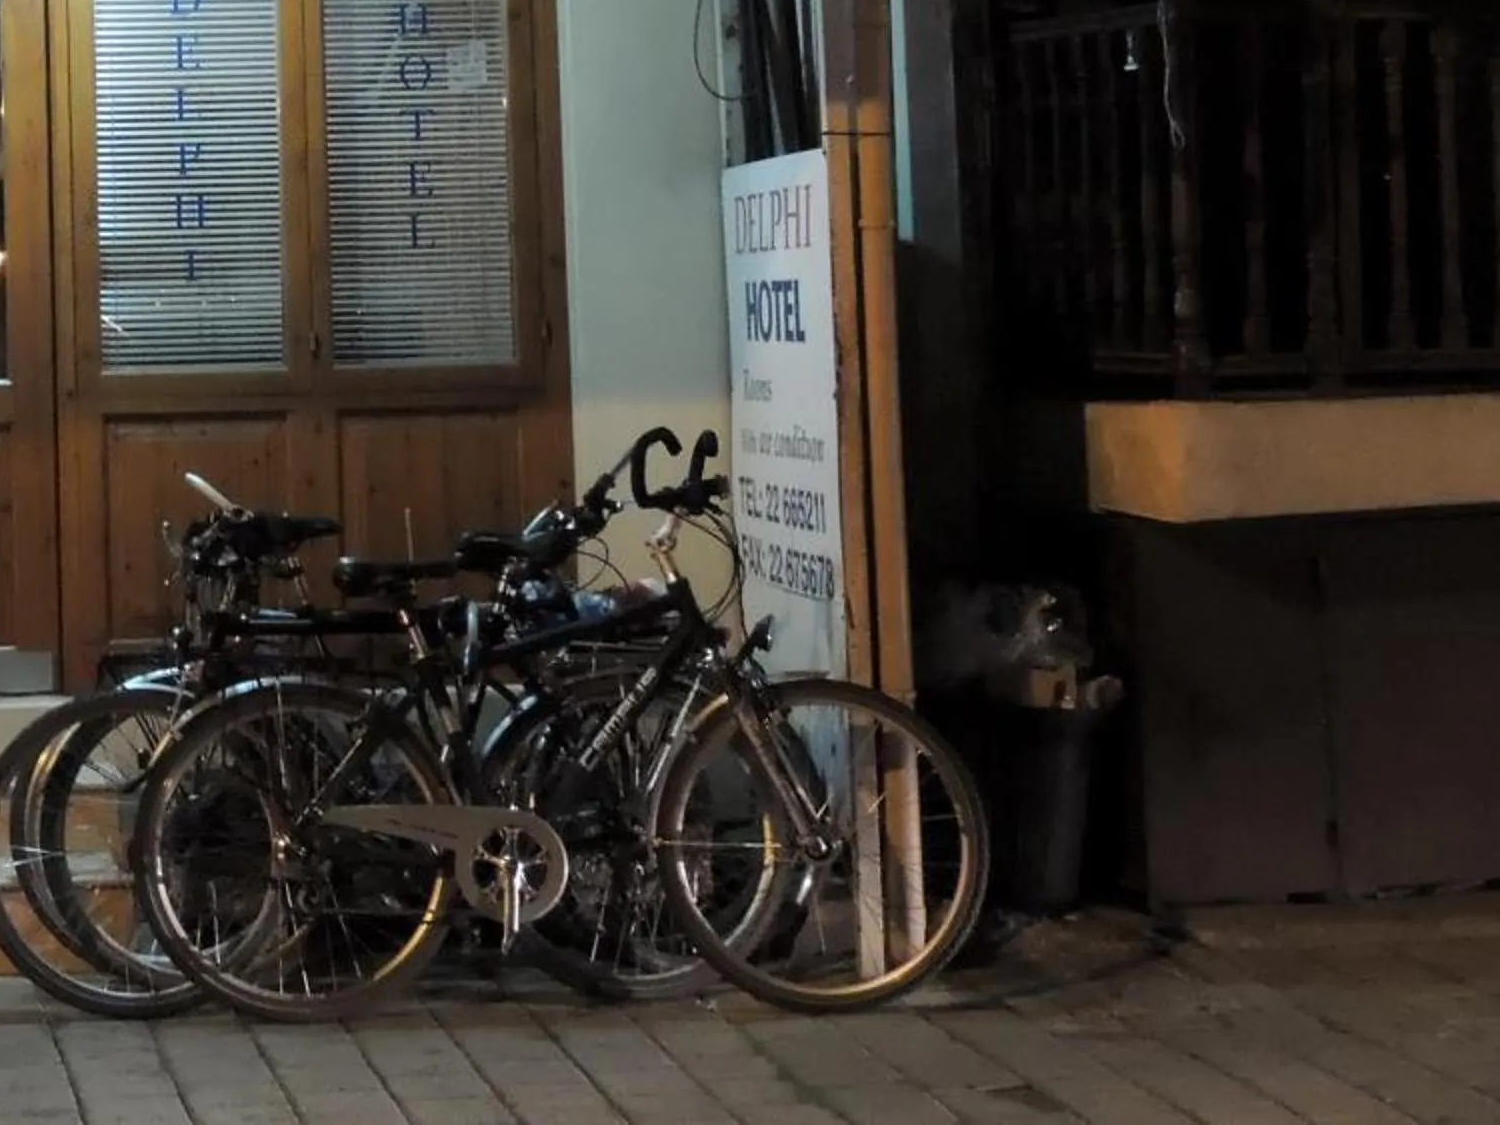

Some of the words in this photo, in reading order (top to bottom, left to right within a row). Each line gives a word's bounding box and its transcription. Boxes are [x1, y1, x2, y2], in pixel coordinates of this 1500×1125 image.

[399, 2, 436, 250] HOTEL
[734, 184, 812, 255] DELPHI
[745, 278, 806, 343] HOTEL
[738, 475, 763, 519] TEL:
[765, 482, 781, 524] 22
[768, 543, 784, 584] 22
